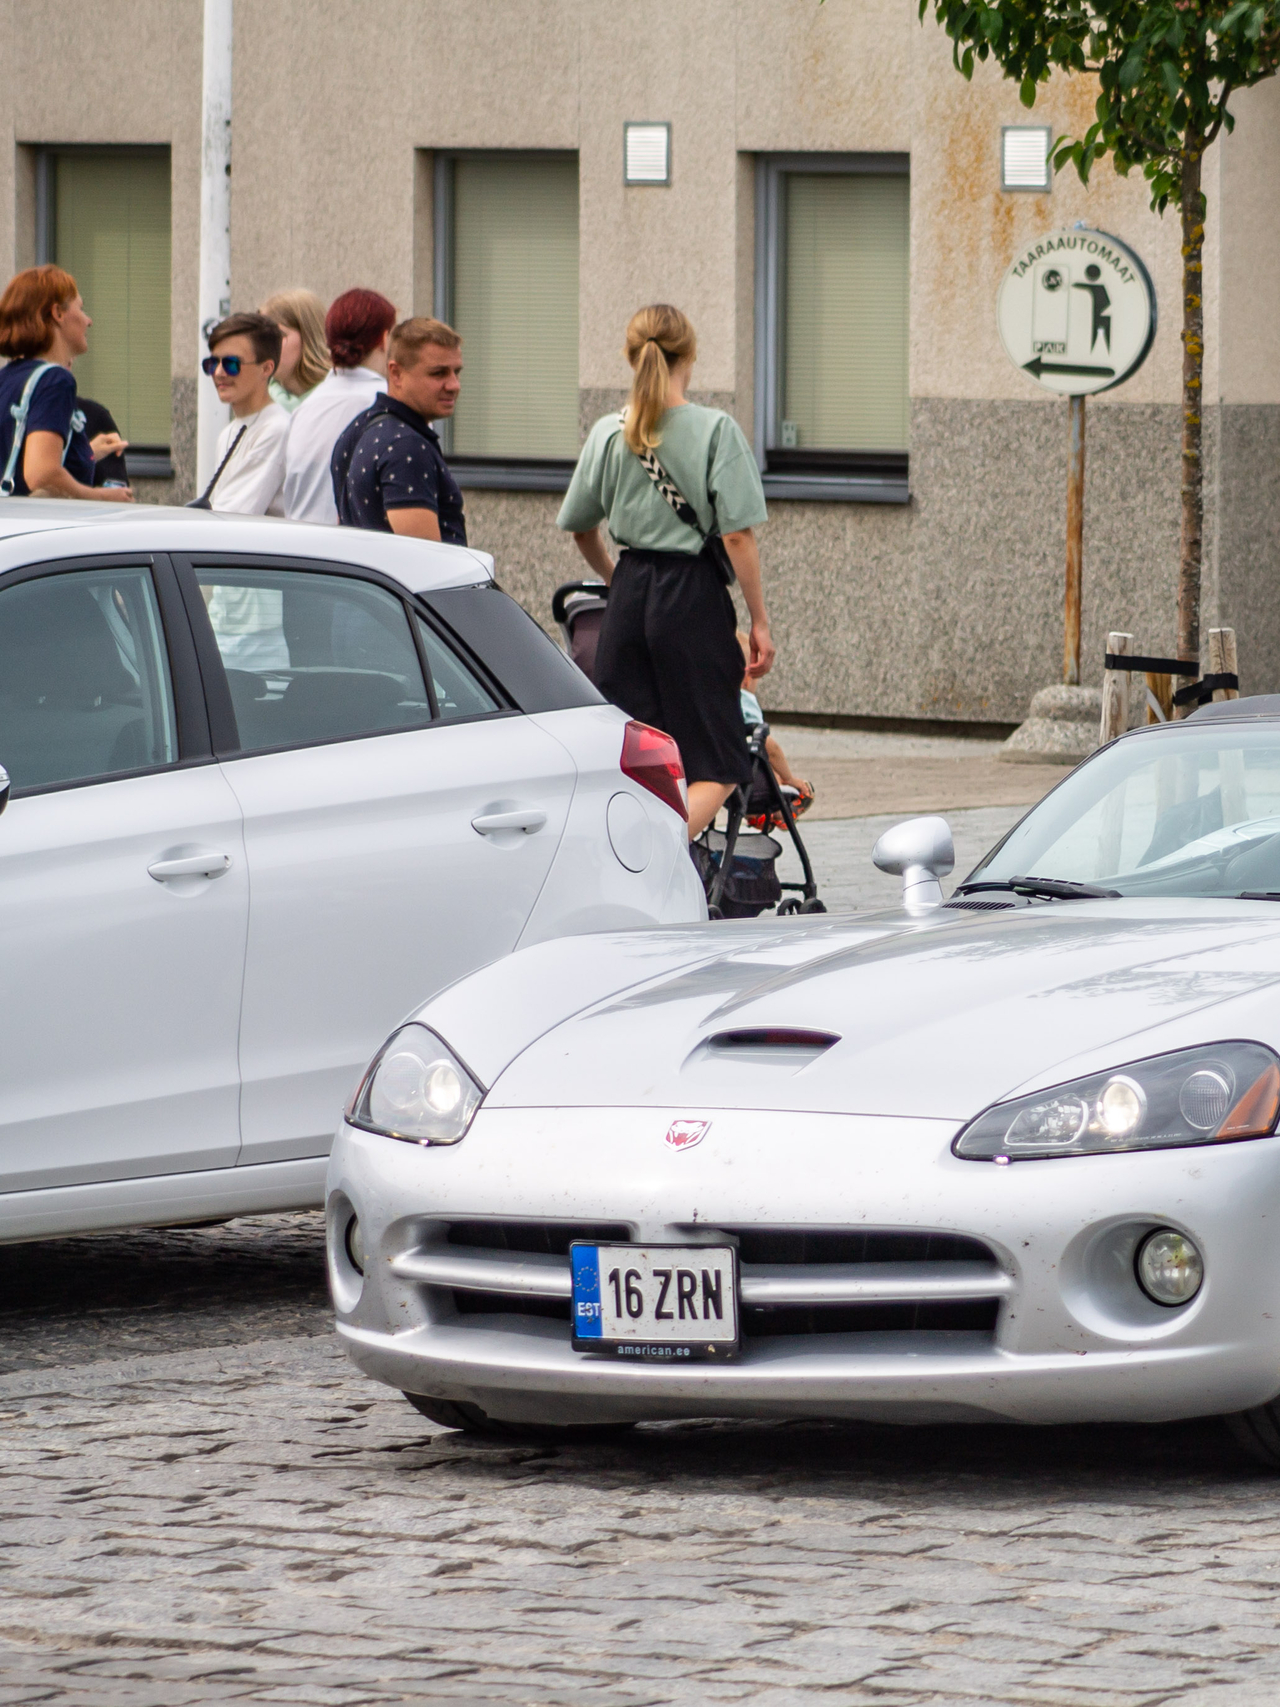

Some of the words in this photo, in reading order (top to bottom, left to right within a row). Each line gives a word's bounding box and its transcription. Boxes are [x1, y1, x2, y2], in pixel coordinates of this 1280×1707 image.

[1012, 236, 1135, 284] TAARAAUTOMAAT
[1033, 341, 1067, 354] PAK
[608, 1267, 644, 1319] 16
[652, 1268, 724, 1321] ZRN
[577, 1302, 600, 1317] EST
[617, 1344, 691, 1356] american.ee
